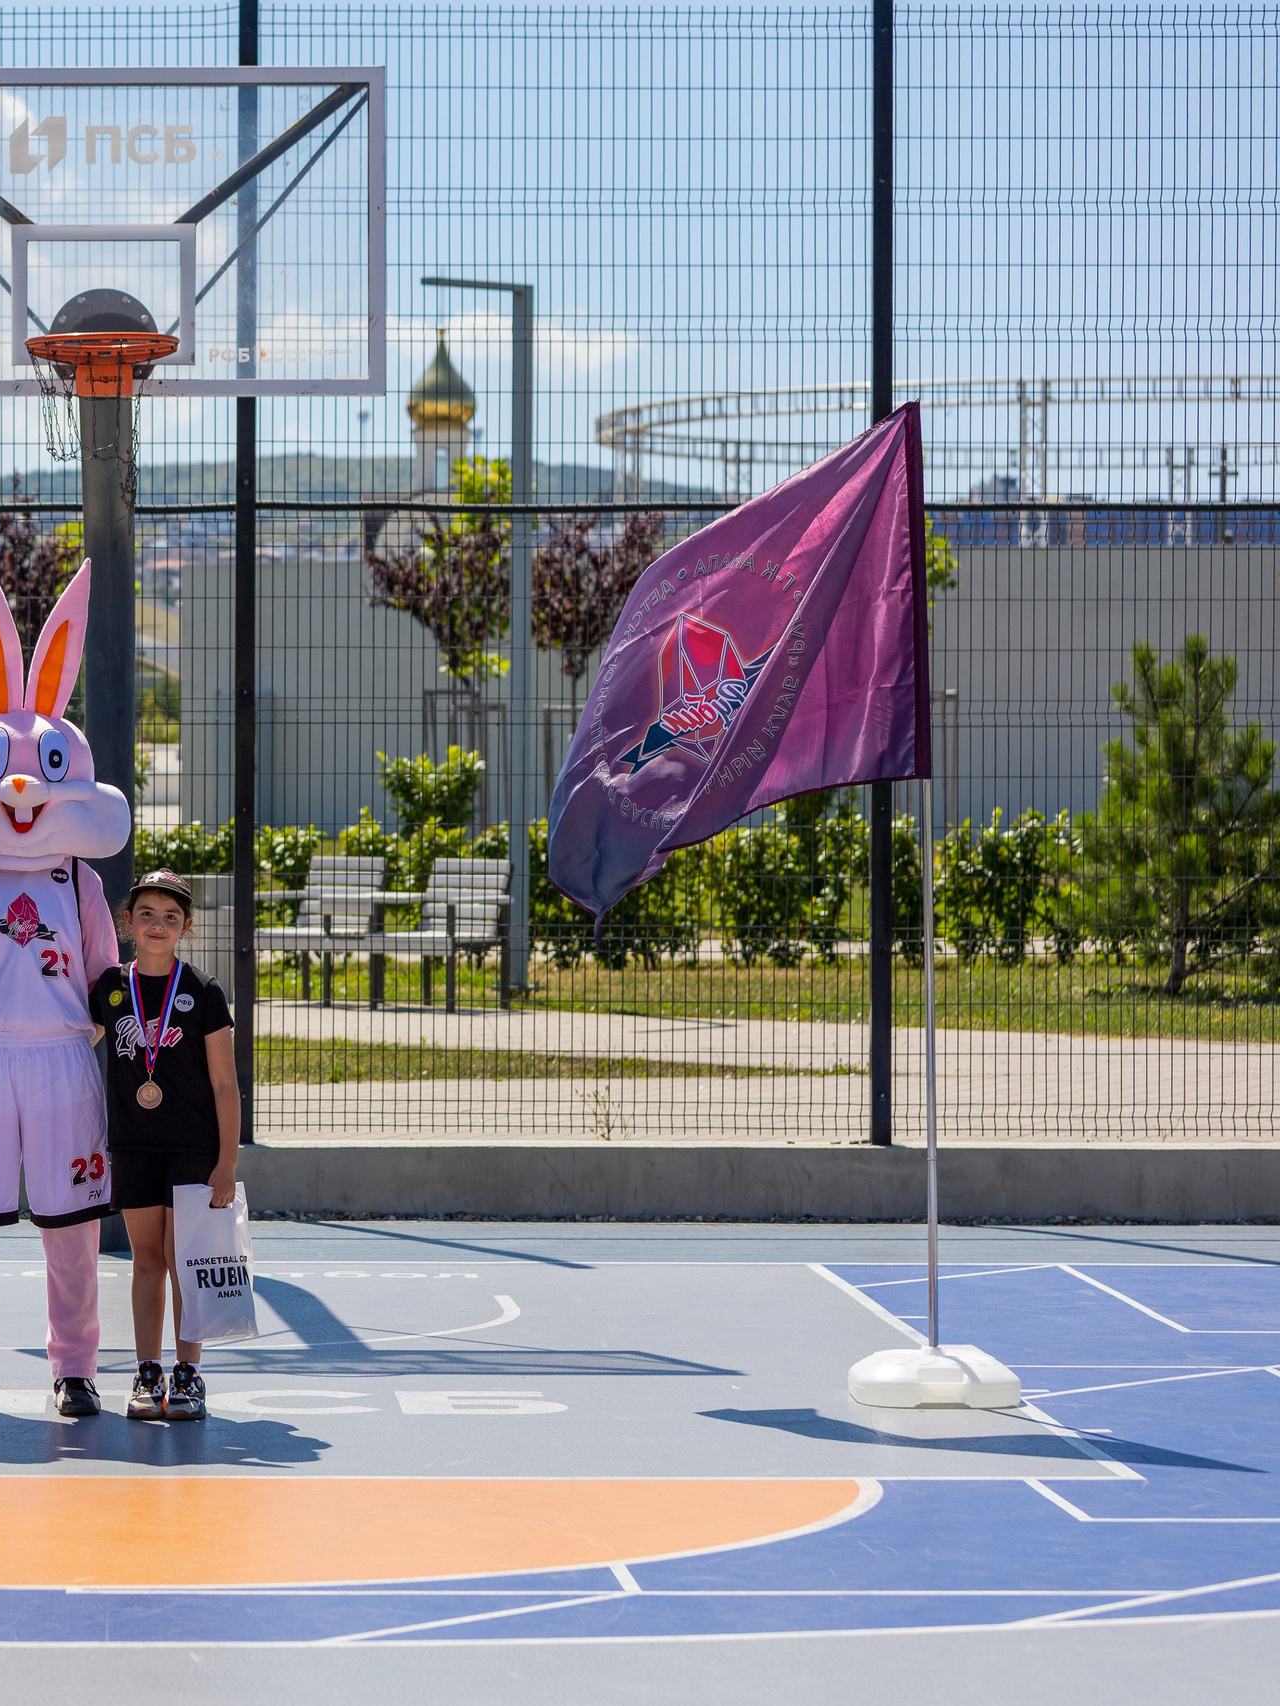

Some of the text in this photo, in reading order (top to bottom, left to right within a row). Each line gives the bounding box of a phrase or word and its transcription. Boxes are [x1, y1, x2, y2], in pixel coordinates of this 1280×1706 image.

[84, 123, 197, 165] ПСБ
[208, 347, 251, 363] РФБ
[176, 998, 193, 1007] РФБ
[69, 1151, 107, 1188] 23
[88, 1189, 102, 1201] FN
[186, 1256, 239, 1268] BASKETBALL
[196, 1265, 251, 1290] RUBIN
[217, 1289, 243, 1299] ANAPA
